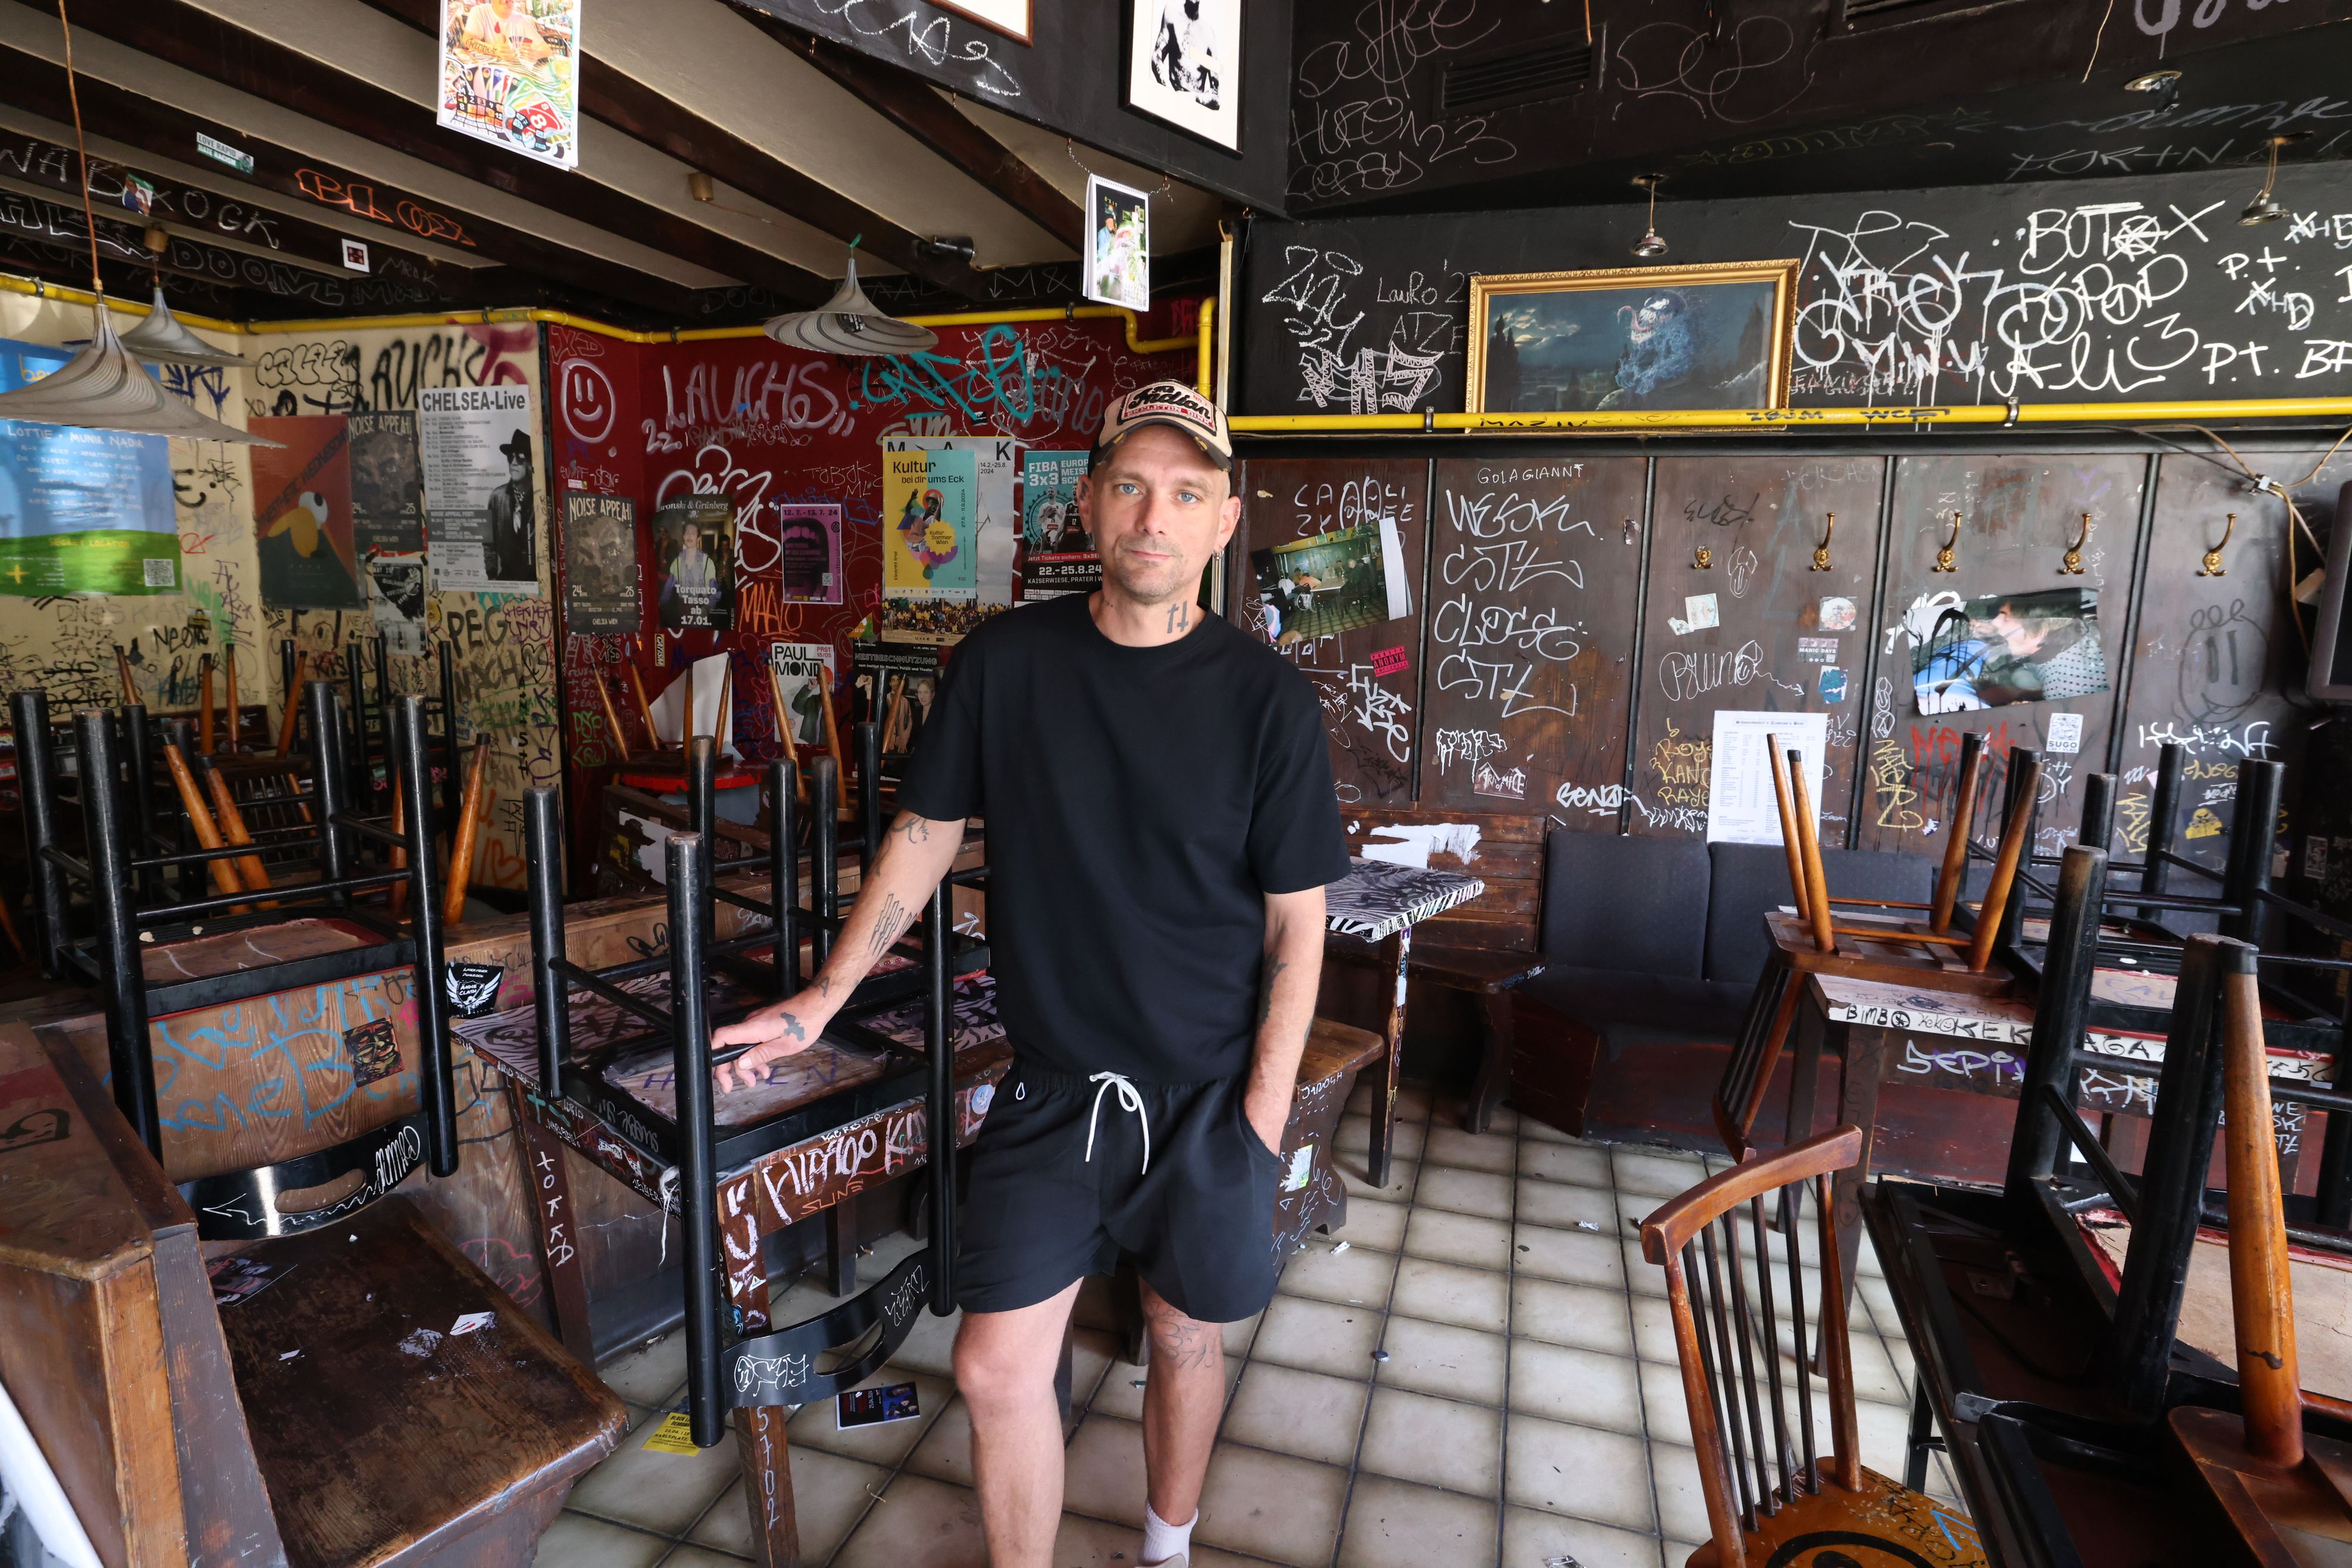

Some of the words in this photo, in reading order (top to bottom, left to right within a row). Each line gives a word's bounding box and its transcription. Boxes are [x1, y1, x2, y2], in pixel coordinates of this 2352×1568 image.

[422, 390, 526, 412] CHELSEA-Live
[1128, 387, 1211, 420] Indian
[7, 424, 54, 440] LOTTIE
[893, 461, 937, 474] Kultur
[1029, 461, 1058, 473] FIBA
[901, 476, 913, 484] bei
[914, 475, 927, 483] dir
[948, 475, 964, 483] Eck
[1029, 473, 1059, 486] 3x3
[569, 497, 596, 523] NOISE
[687, 500, 694, 509] &
[695, 500, 729, 511] Grünberg
[675, 584, 717, 596] Torquato
[682, 595, 710, 604] Tasso
[690, 606, 702, 615] ab
[681, 616, 712, 626] 17.01.
[775, 646, 824, 661] PAUL
[854, 653, 937, 666] NESTBESCHMUTZUNG
[1374, 652, 1406, 668] ANONYM
[1495, 781, 1505, 791] of
[1502, 768, 1526, 795] MICE
